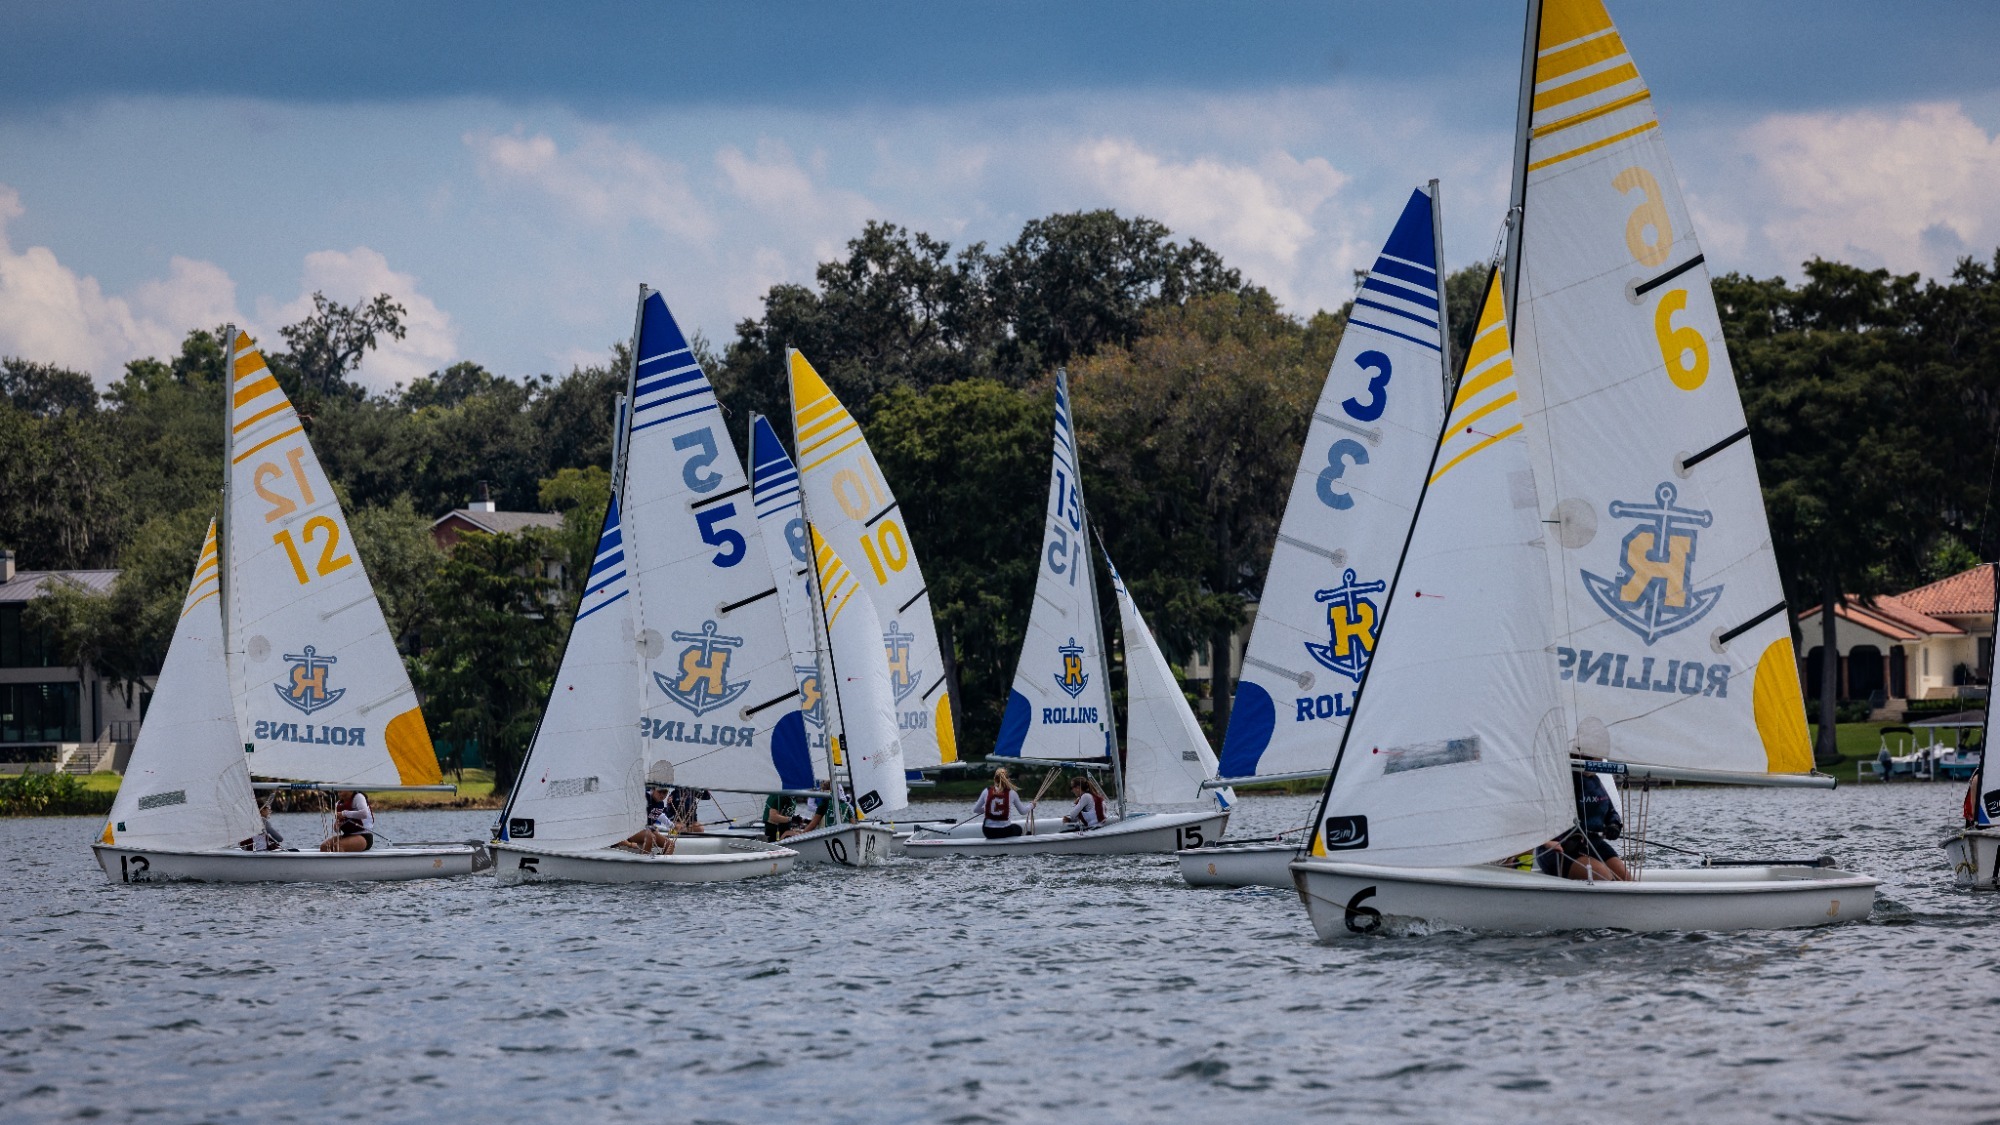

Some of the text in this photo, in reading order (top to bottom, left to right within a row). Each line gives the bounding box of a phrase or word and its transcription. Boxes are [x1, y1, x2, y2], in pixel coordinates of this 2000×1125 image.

[1655, 288, 1710, 391] 6
[1341, 350, 1392, 422] 3
[1056, 468, 1080, 532] 15
[272, 515, 353, 585] 12
[695, 502, 747, 568] 5
[859, 519, 908, 586] 10
[1328, 598, 1377, 660] R
[1063, 654, 1082, 685] R
[1042, 706, 1098, 725] ROLLINS
[1587, 761, 1617, 769] SPERRY
[990, 796, 1005, 817] C
[824, 838, 848, 864] 10
[1176, 825, 1204, 850] 15
[1344, 885, 1382, 934] 6
